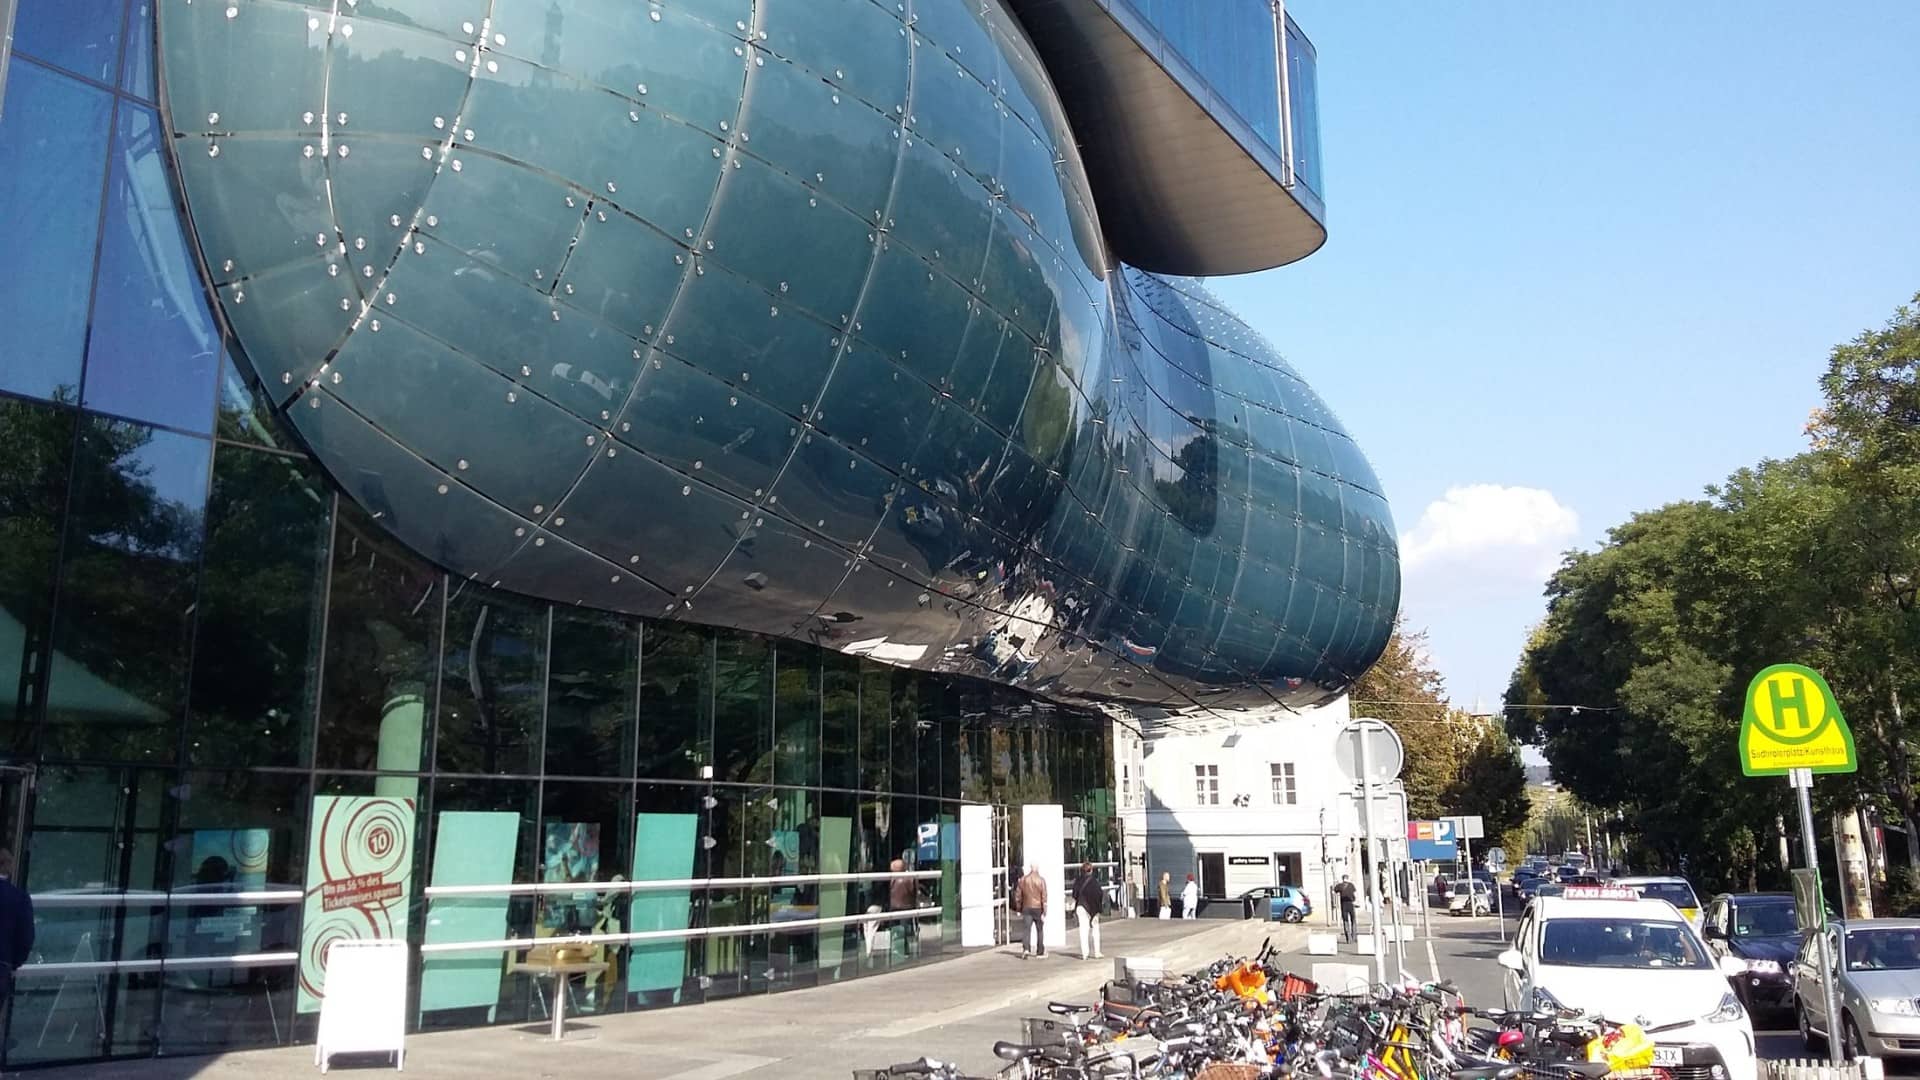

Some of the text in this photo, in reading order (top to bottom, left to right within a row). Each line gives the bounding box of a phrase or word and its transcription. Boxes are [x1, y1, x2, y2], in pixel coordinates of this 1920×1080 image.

[1768, 679, 1811, 730] H
[1433, 821, 1450, 840] P
[371, 832, 388, 853] 10
[366, 875, 380, 887] des
[1567, 887, 1599, 898] TAXI
